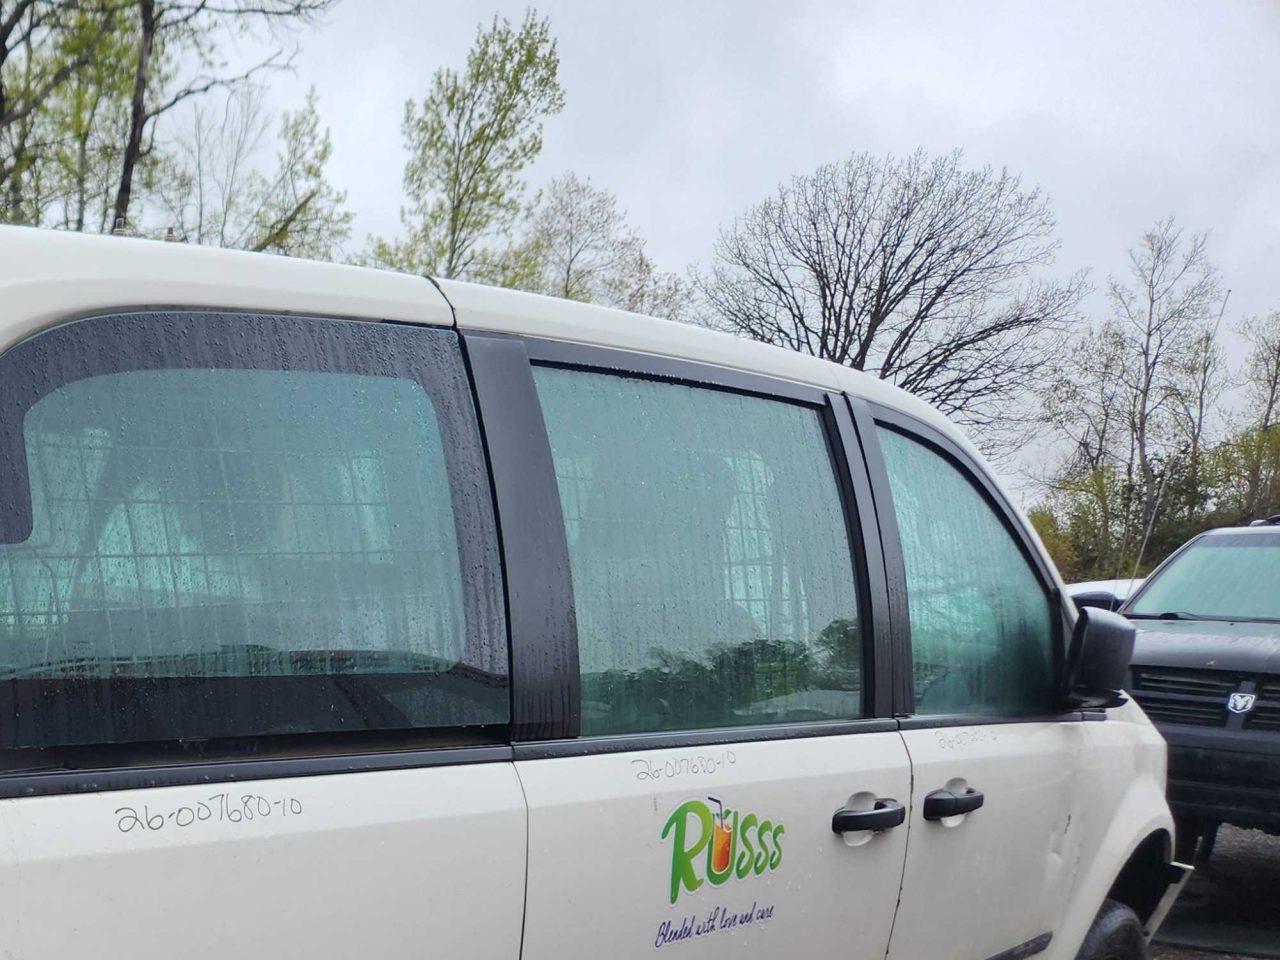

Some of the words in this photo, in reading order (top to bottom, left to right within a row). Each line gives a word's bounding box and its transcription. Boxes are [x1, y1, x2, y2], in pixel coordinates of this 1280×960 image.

[114, 793, 303, 833] 26-007680-10
[655, 915, 696, 948] Blended
[696, 906, 720, 935] with
[720, 907, 738, 929] love
[739, 901, 757, 925] and
[756, 905, 774, 921] care
